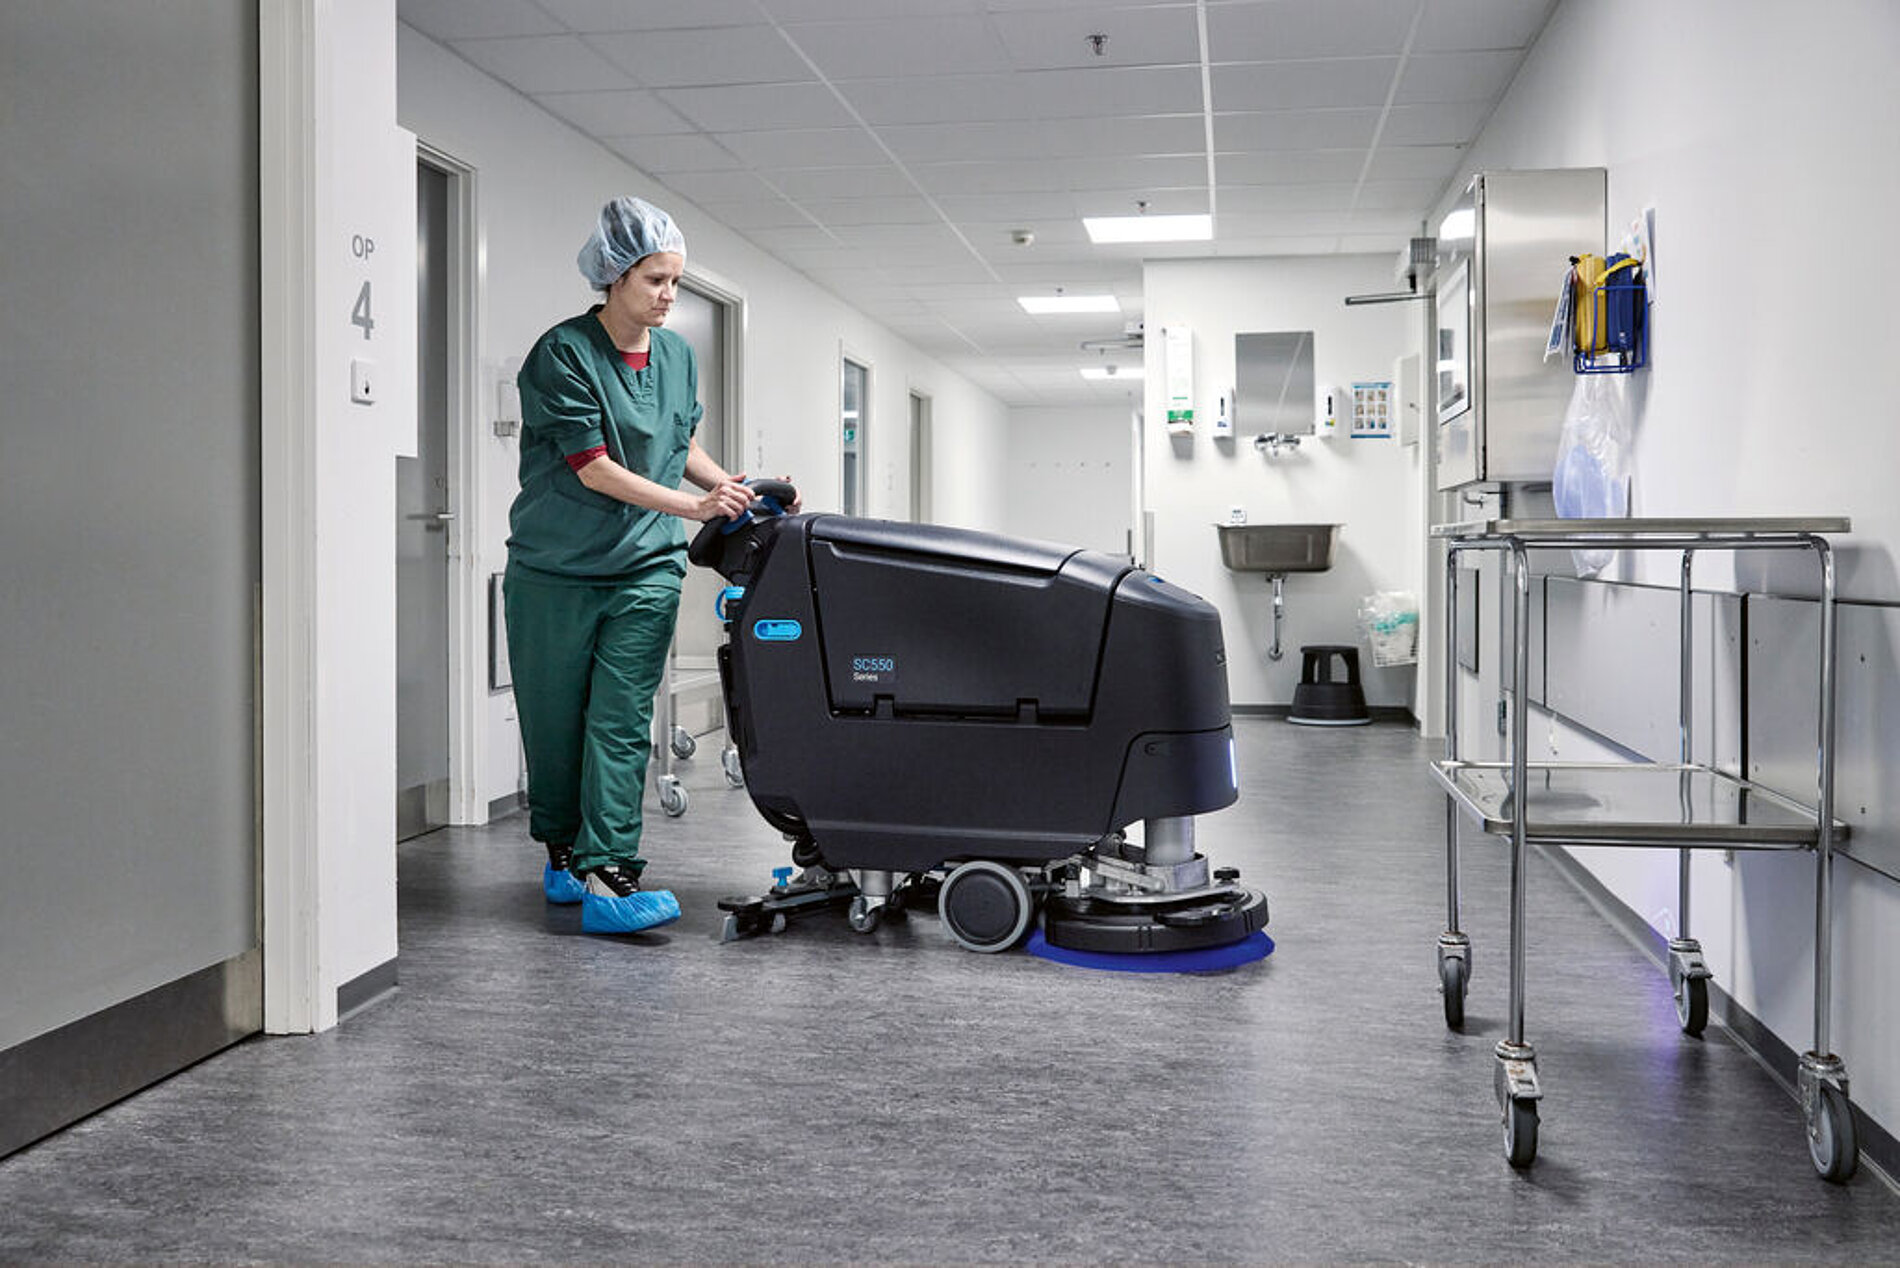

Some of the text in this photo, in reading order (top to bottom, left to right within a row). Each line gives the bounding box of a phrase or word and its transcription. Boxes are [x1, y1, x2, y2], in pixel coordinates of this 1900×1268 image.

[352, 234, 375, 260] OP
[351, 281, 374, 340] 4
[853, 658, 894, 671] SC550
[853, 671, 879, 682] Series
